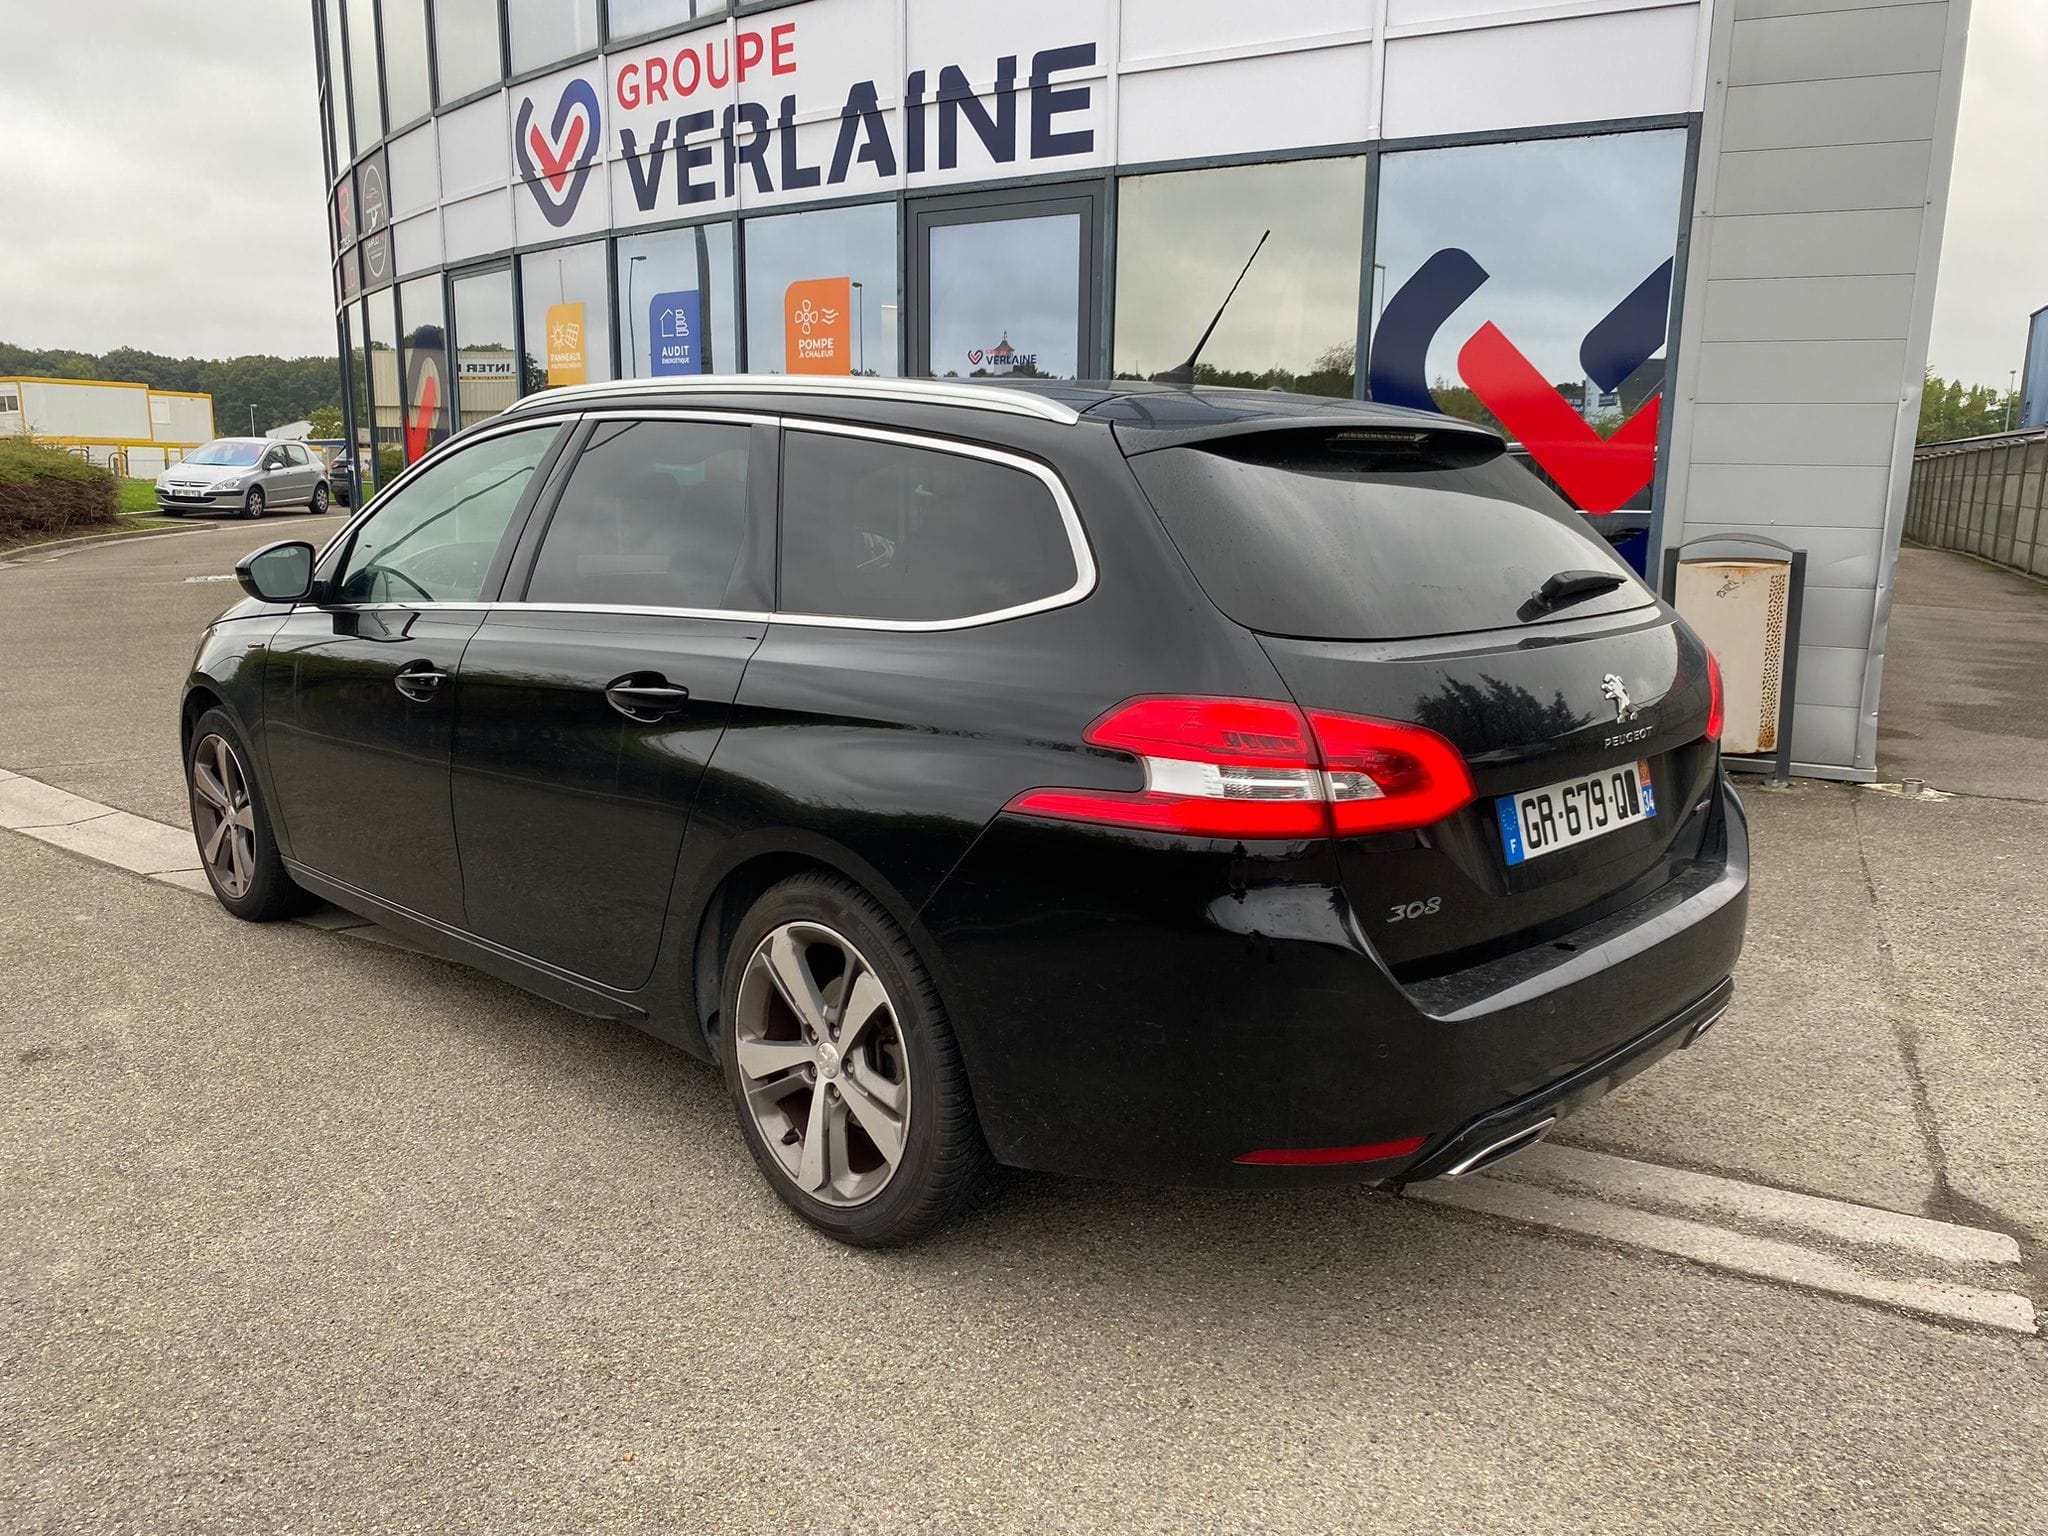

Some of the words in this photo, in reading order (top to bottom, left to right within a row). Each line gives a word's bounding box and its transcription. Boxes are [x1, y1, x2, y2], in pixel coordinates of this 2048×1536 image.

[617, 22, 797, 110] GROUPE
[619, 42, 1097, 212] VERLAINE
[662, 345, 690, 357] AUDIT
[799, 338, 834, 350] POMPE
[805, 350, 834, 358] CHALEUR
[986, 354, 1037, 365] VERLAINE
[1604, 726, 1653, 749] PEUGEOT
[1509, 838, 1517, 854] F
[1643, 788, 1655, 812] 34
[1386, 896, 1442, 923] 308
